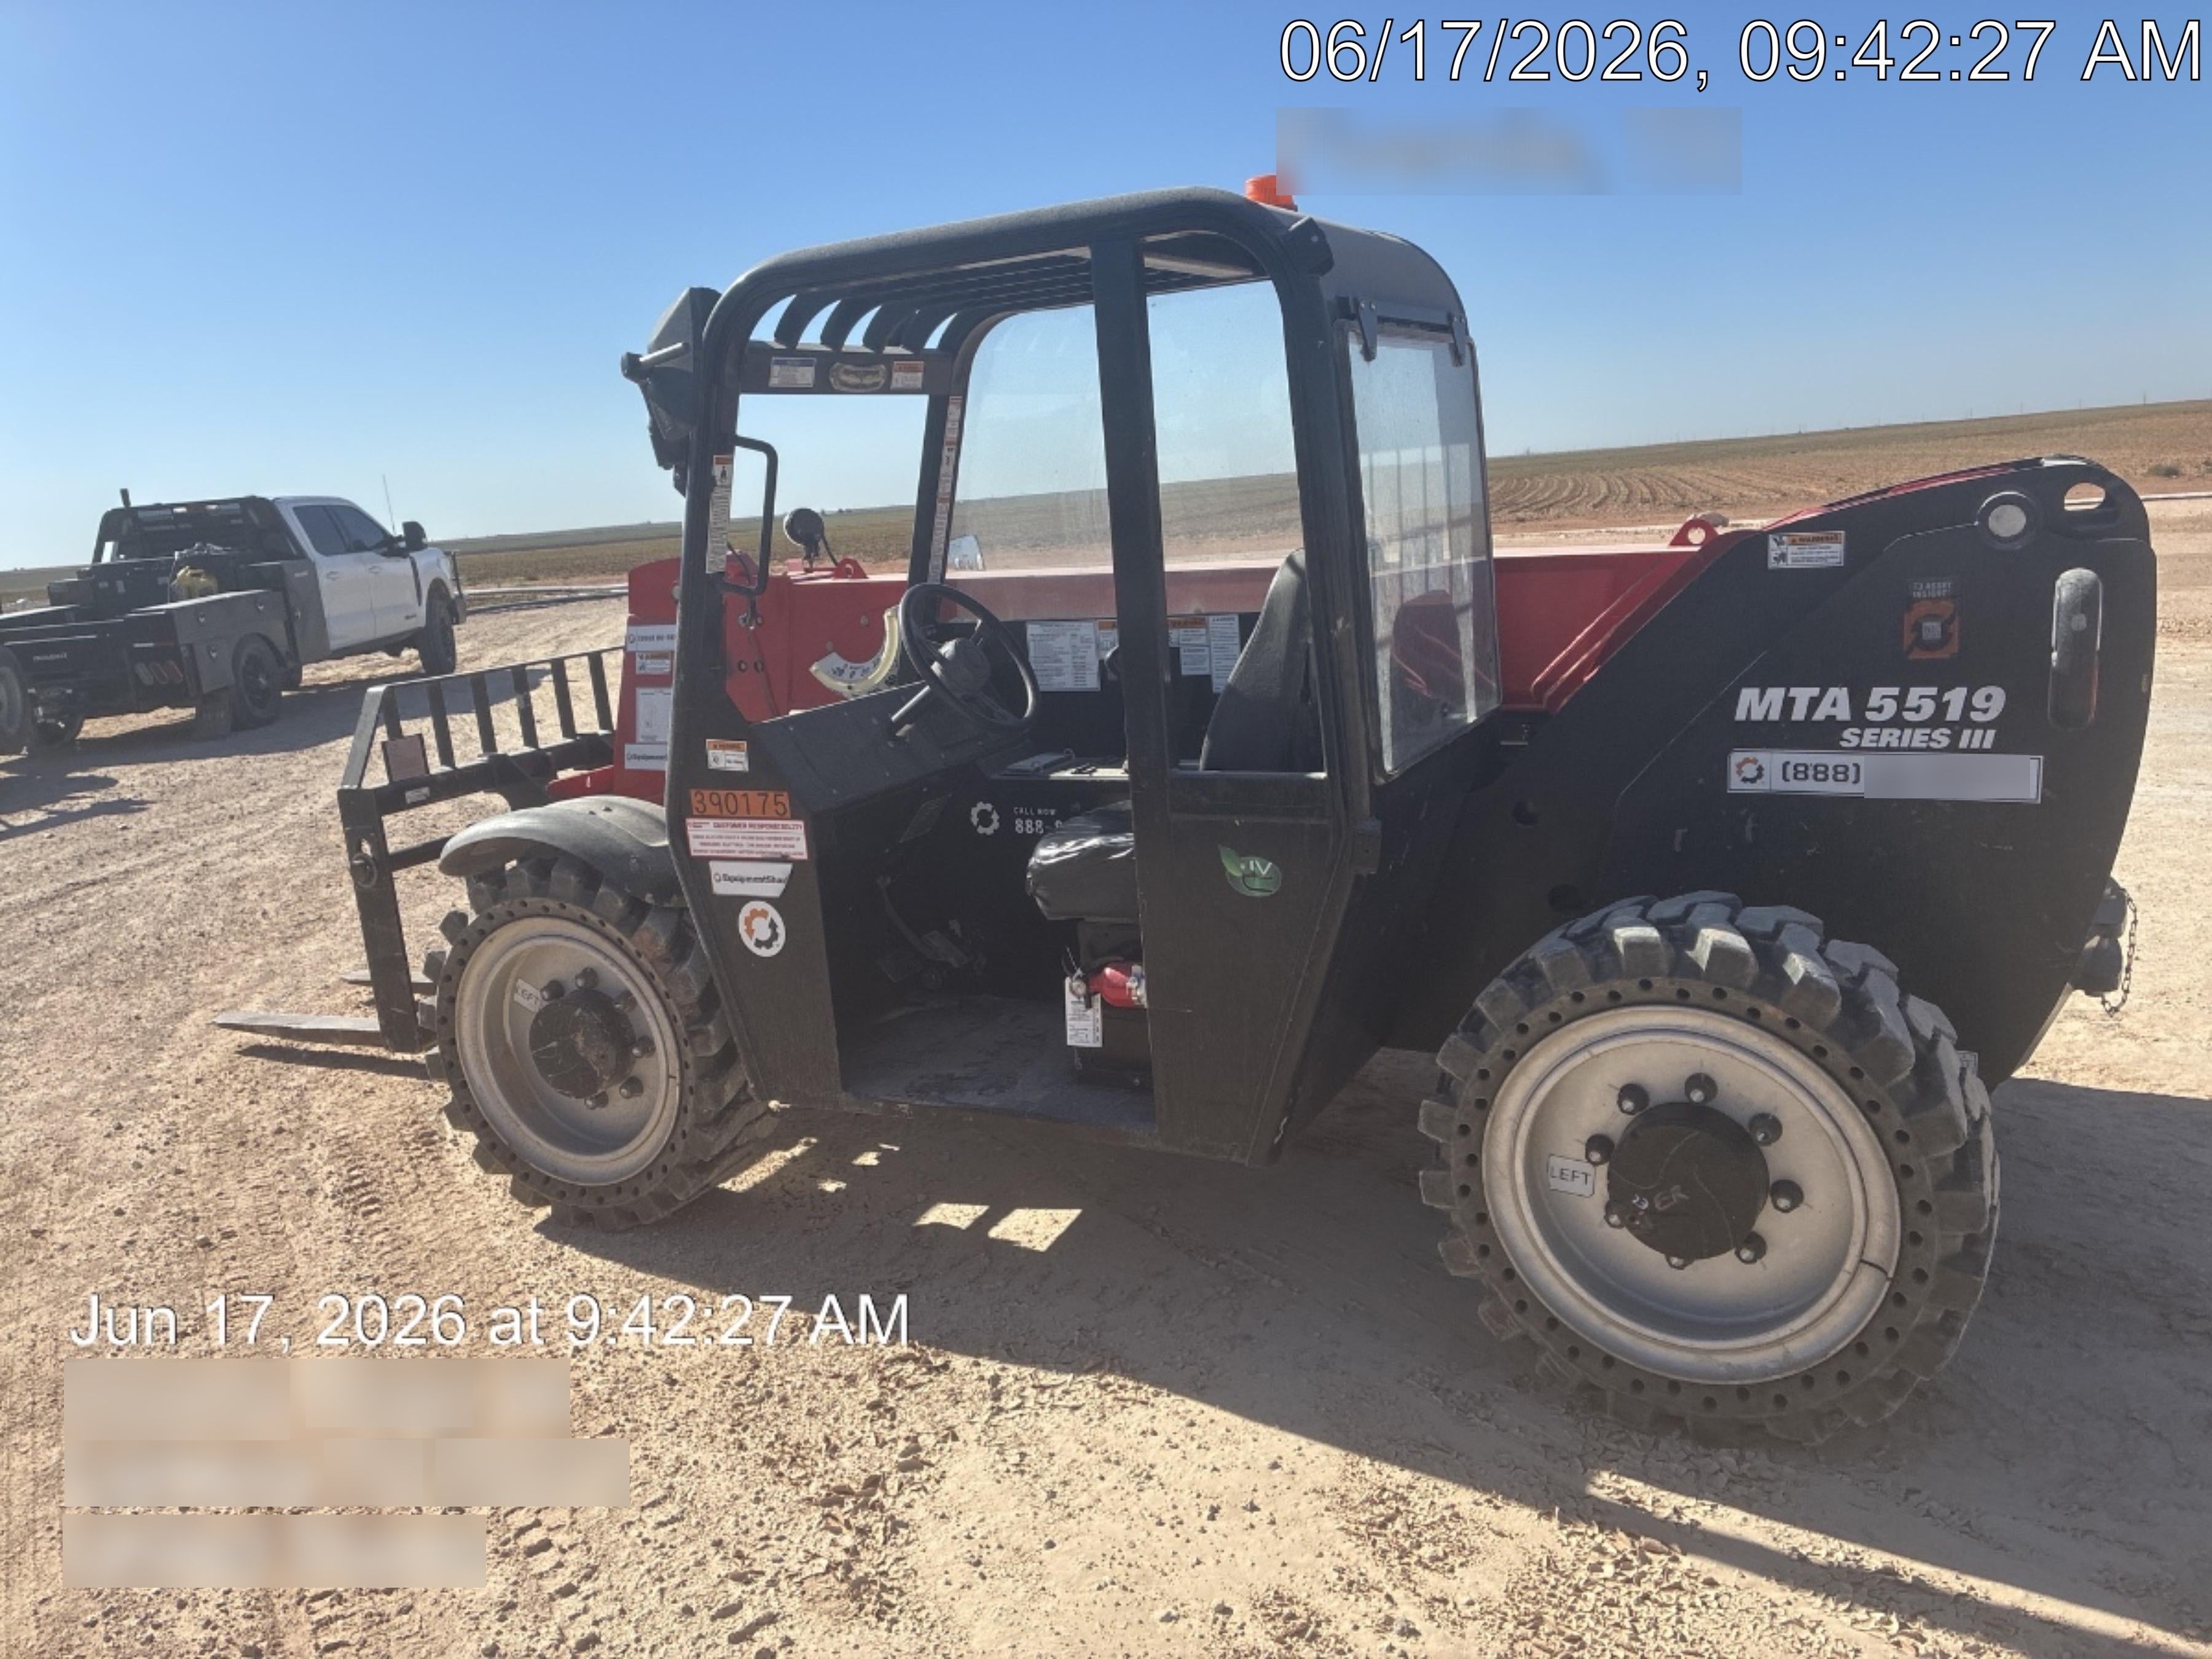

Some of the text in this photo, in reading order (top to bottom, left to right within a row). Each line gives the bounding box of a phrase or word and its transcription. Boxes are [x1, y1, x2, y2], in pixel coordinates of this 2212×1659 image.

[1734, 685, 2007, 723] MTA 5519
[1838, 727, 1996, 749] SERIES III
[1781, 760, 1861, 785] (888)
[694, 790, 788, 817] 390175
[1550, 1166, 1591, 1186] LEFT
